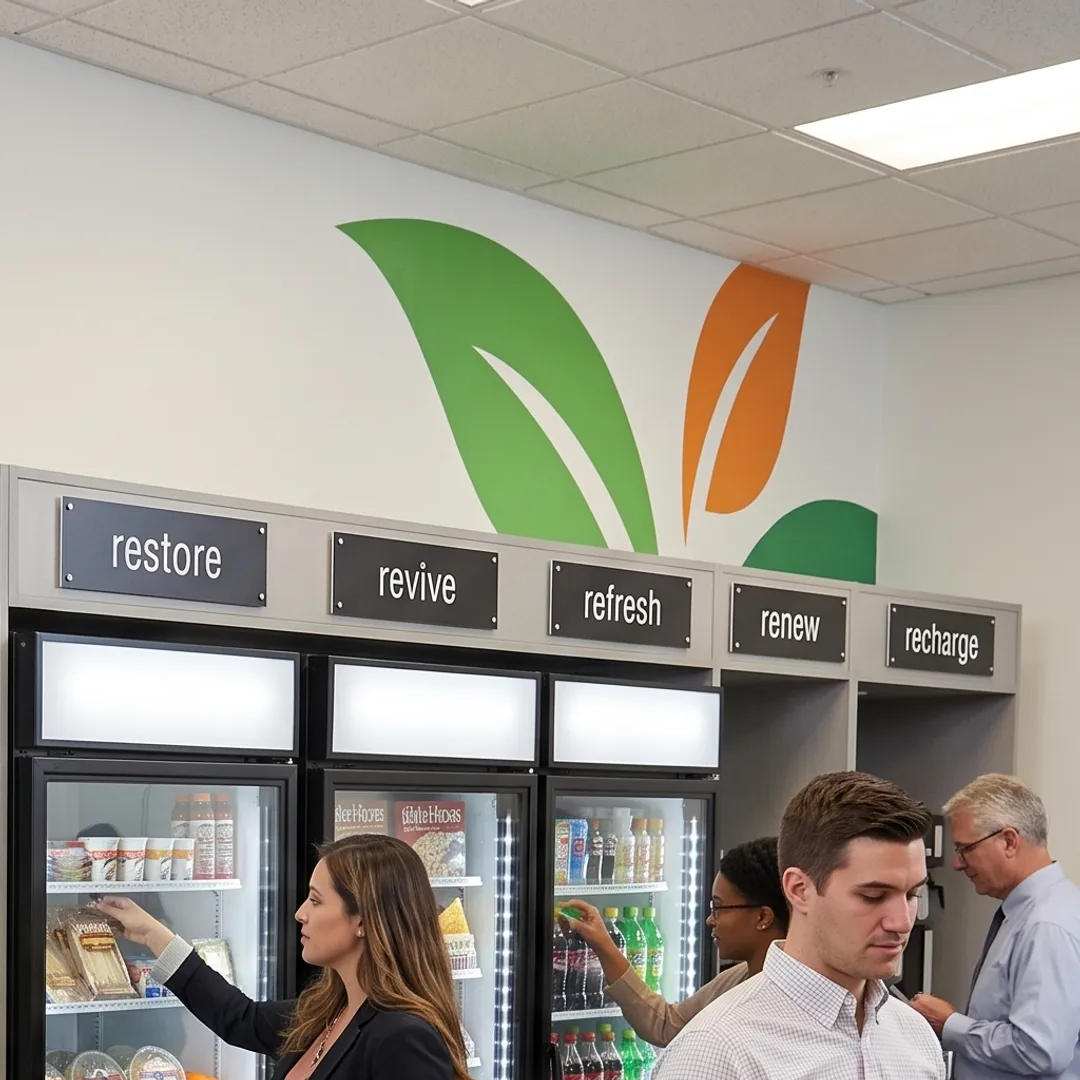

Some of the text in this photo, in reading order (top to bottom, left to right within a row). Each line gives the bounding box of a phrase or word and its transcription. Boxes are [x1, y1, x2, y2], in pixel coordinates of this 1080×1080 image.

[111, 533, 223, 580] restore
[378, 561, 457, 605] revive
[583, 585, 662, 627] refresh
[760, 608, 820, 643] renew
[904, 623, 979, 664] recharge
